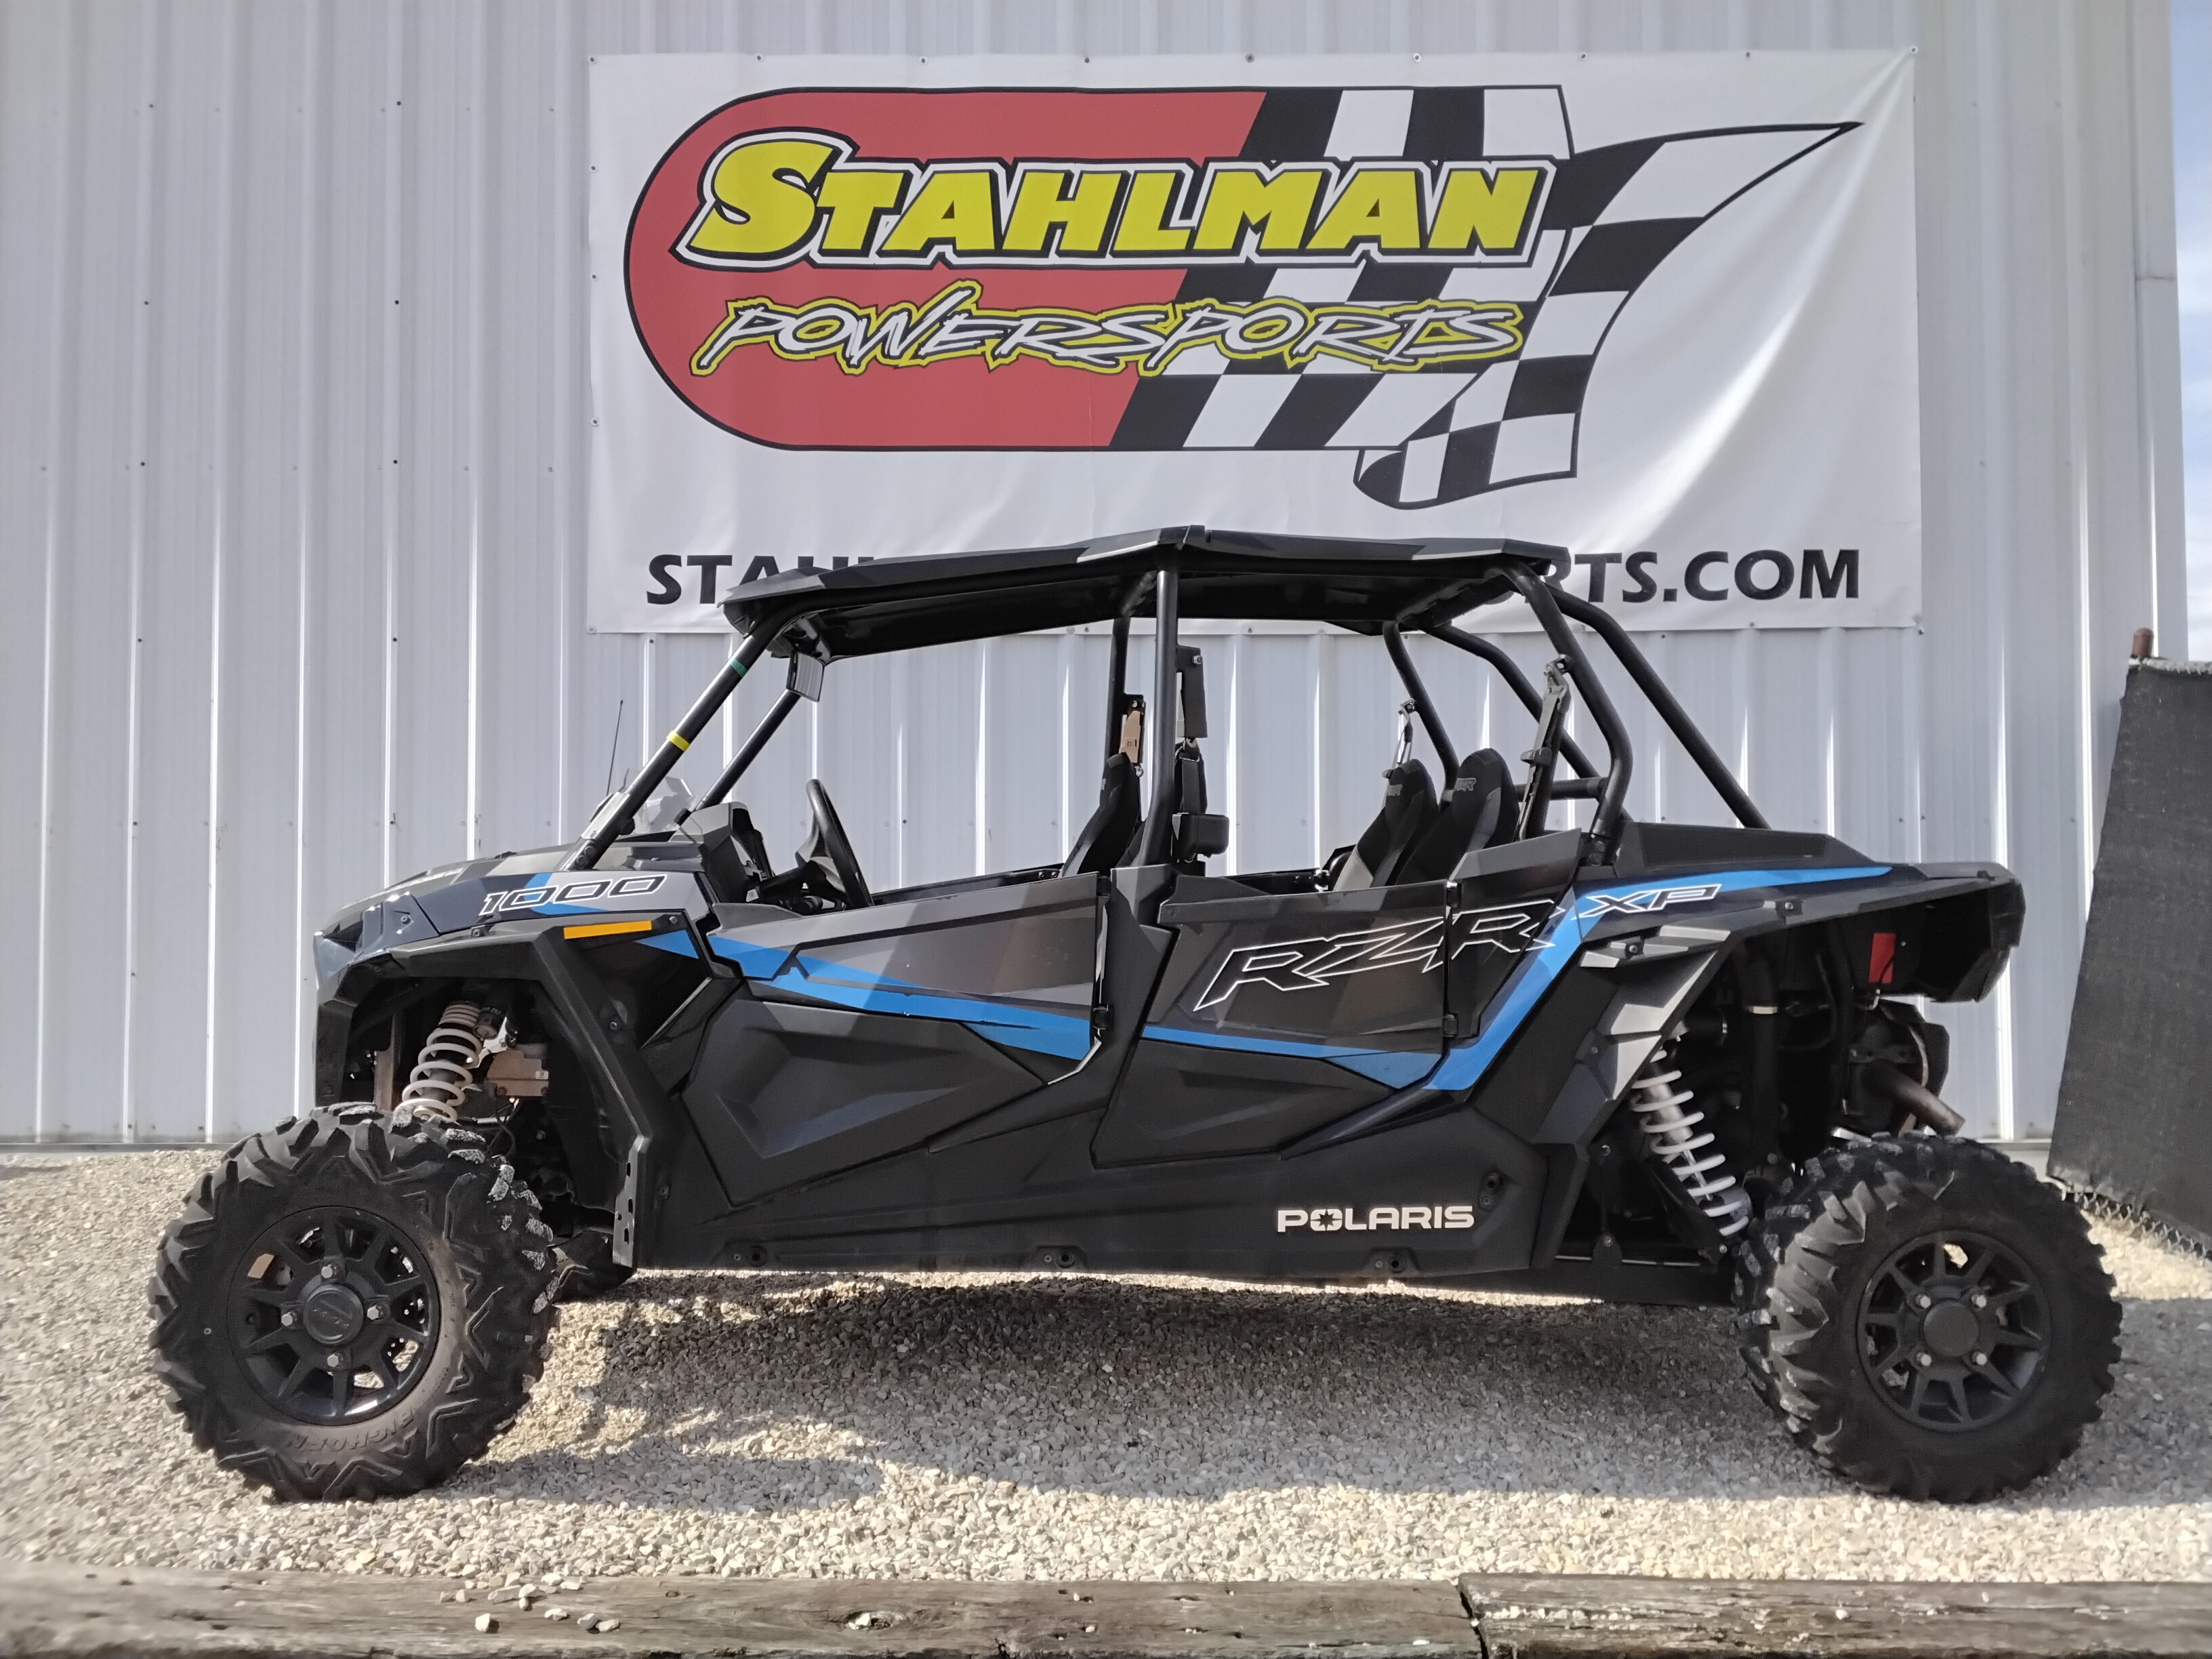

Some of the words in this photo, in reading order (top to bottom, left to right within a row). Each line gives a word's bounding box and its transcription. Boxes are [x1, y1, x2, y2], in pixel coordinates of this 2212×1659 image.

[683, 137, 1547, 260] STAHLMAN
[695, 283, 1521, 372] POWERSPORTS
[479, 874, 668, 916] 1000
[1193, 898, 1564, 1011] RZR
[1571, 883, 1722, 920] XP
[1277, 1205, 1475, 1233] POLARIS
